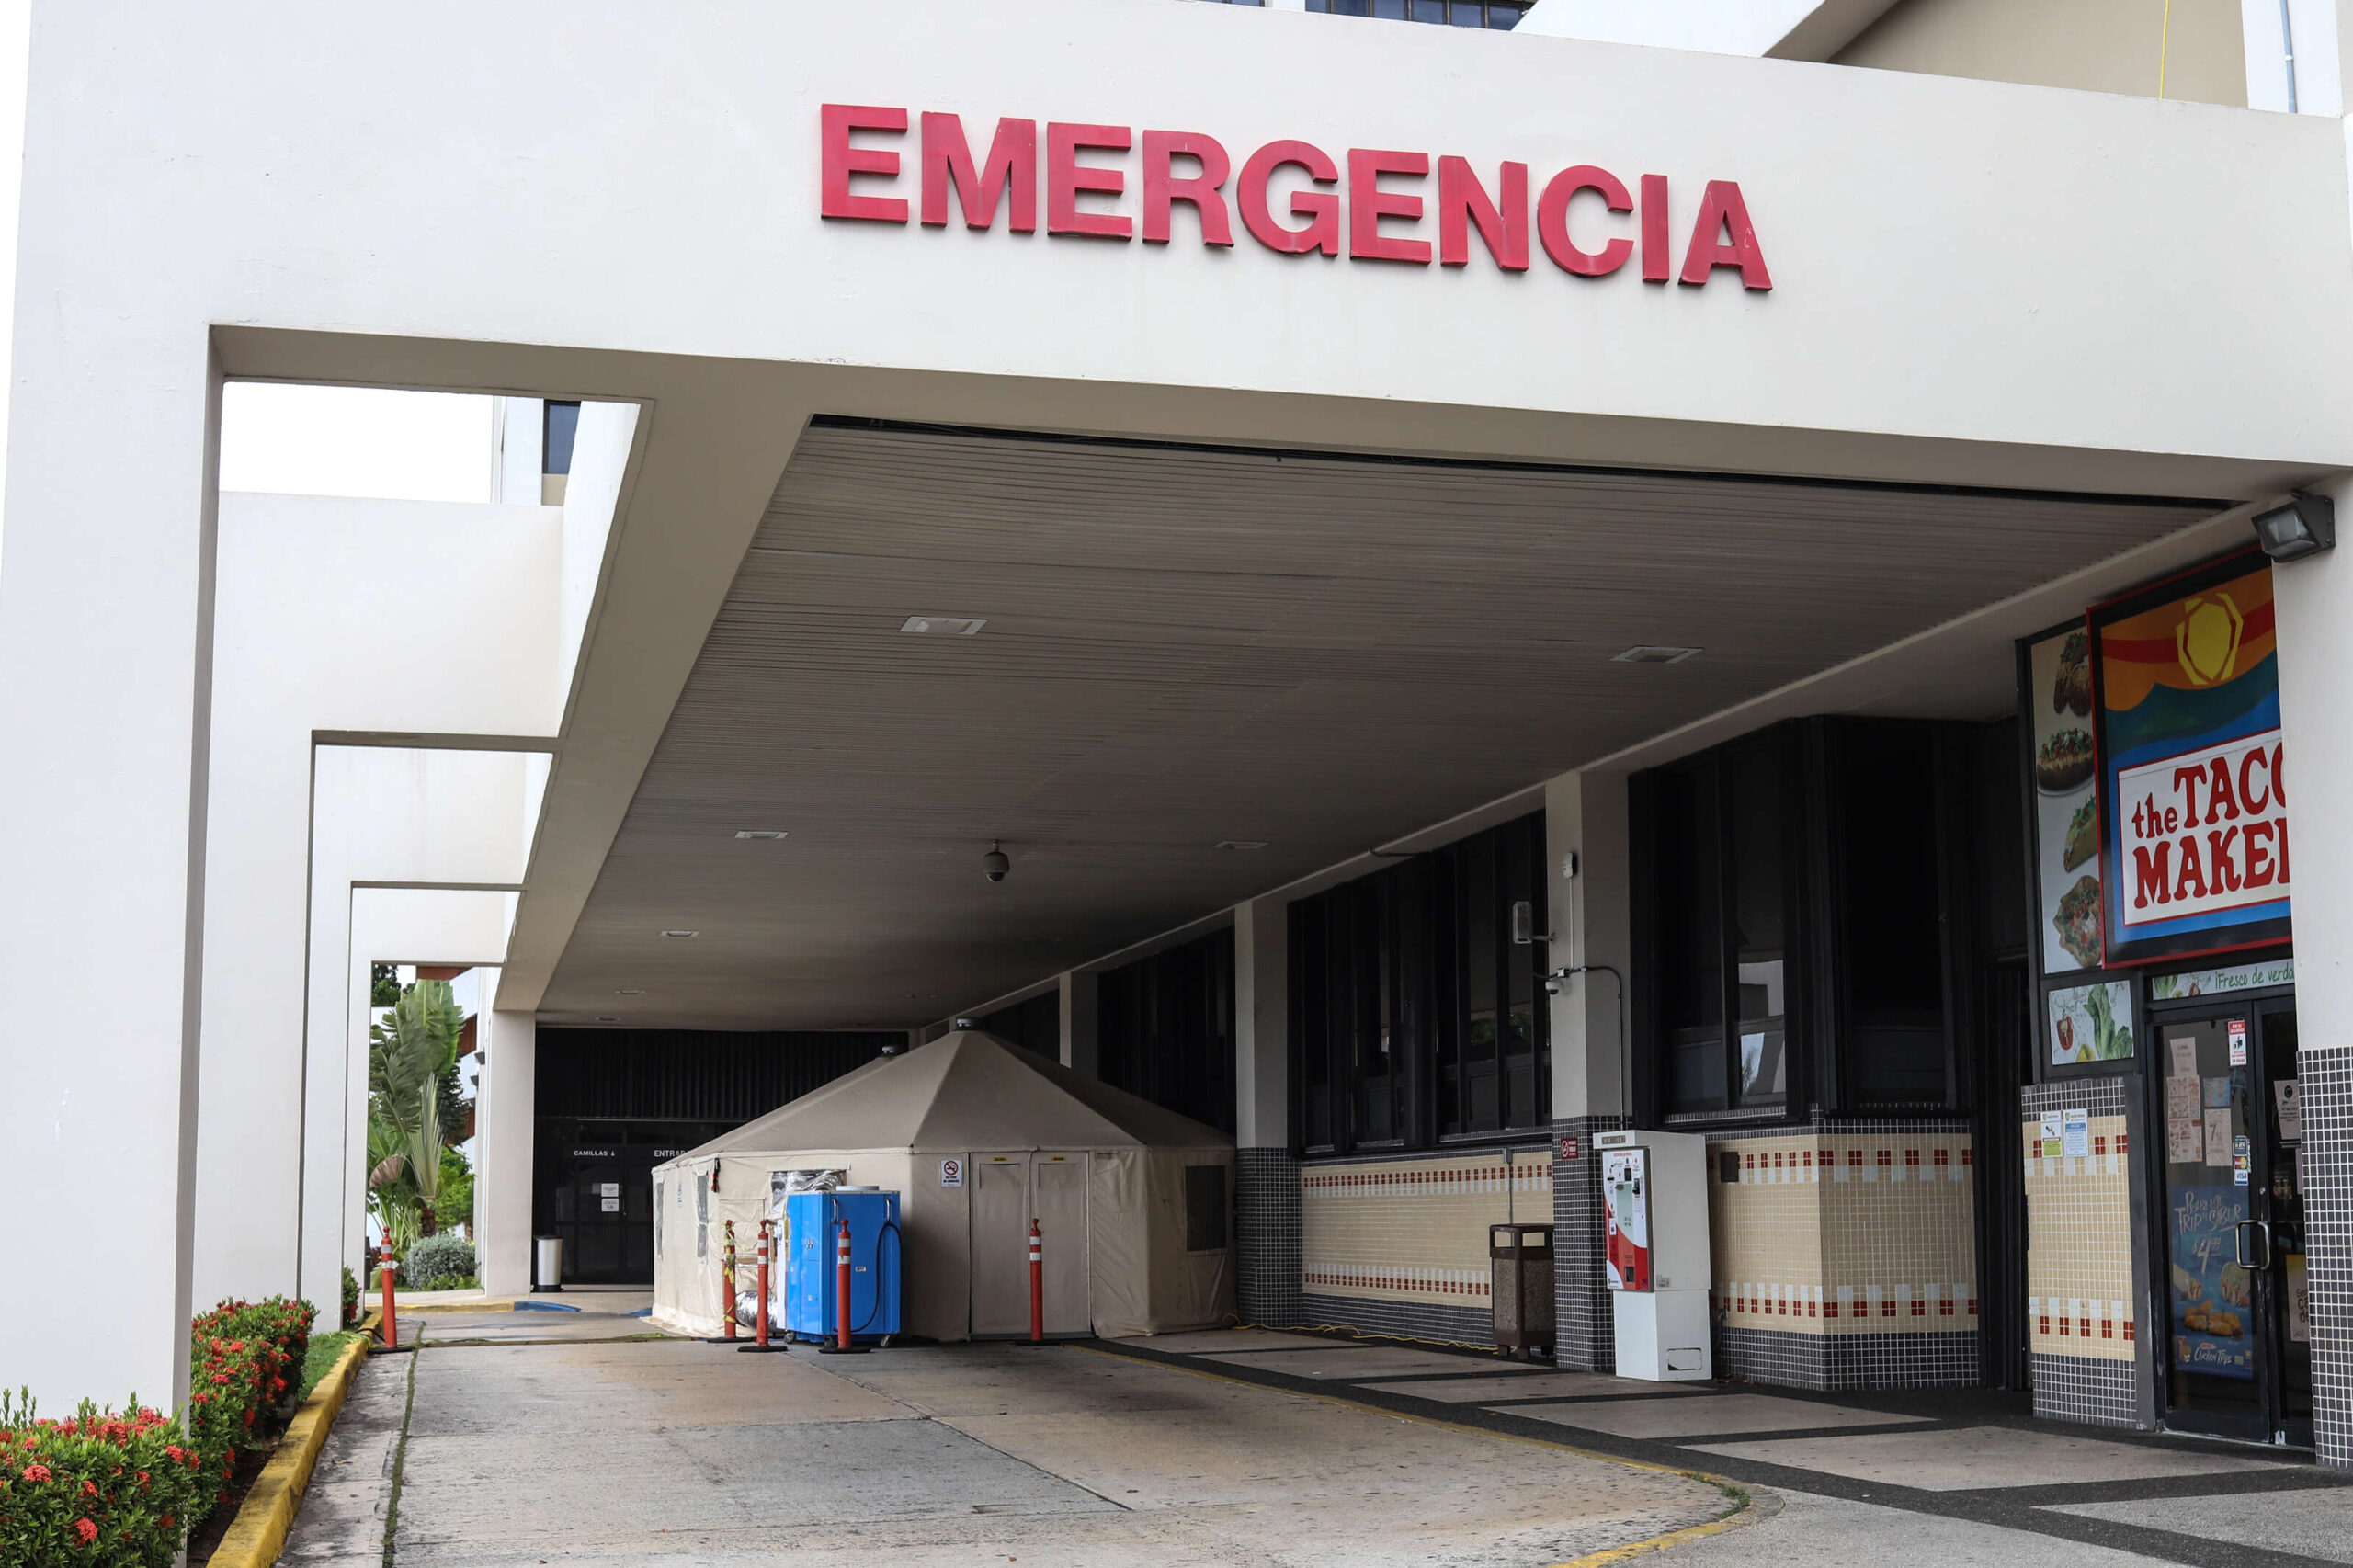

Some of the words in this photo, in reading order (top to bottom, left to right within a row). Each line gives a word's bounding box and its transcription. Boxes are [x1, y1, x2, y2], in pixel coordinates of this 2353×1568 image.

[821, 103, 1773, 292] EMERGENCIA
[2131, 792, 2178, 839] the
[2252, 966, 2264, 984] de
[2236, 1172, 2247, 1180] VISA
[2174, 1207, 2203, 1235] TRIP
